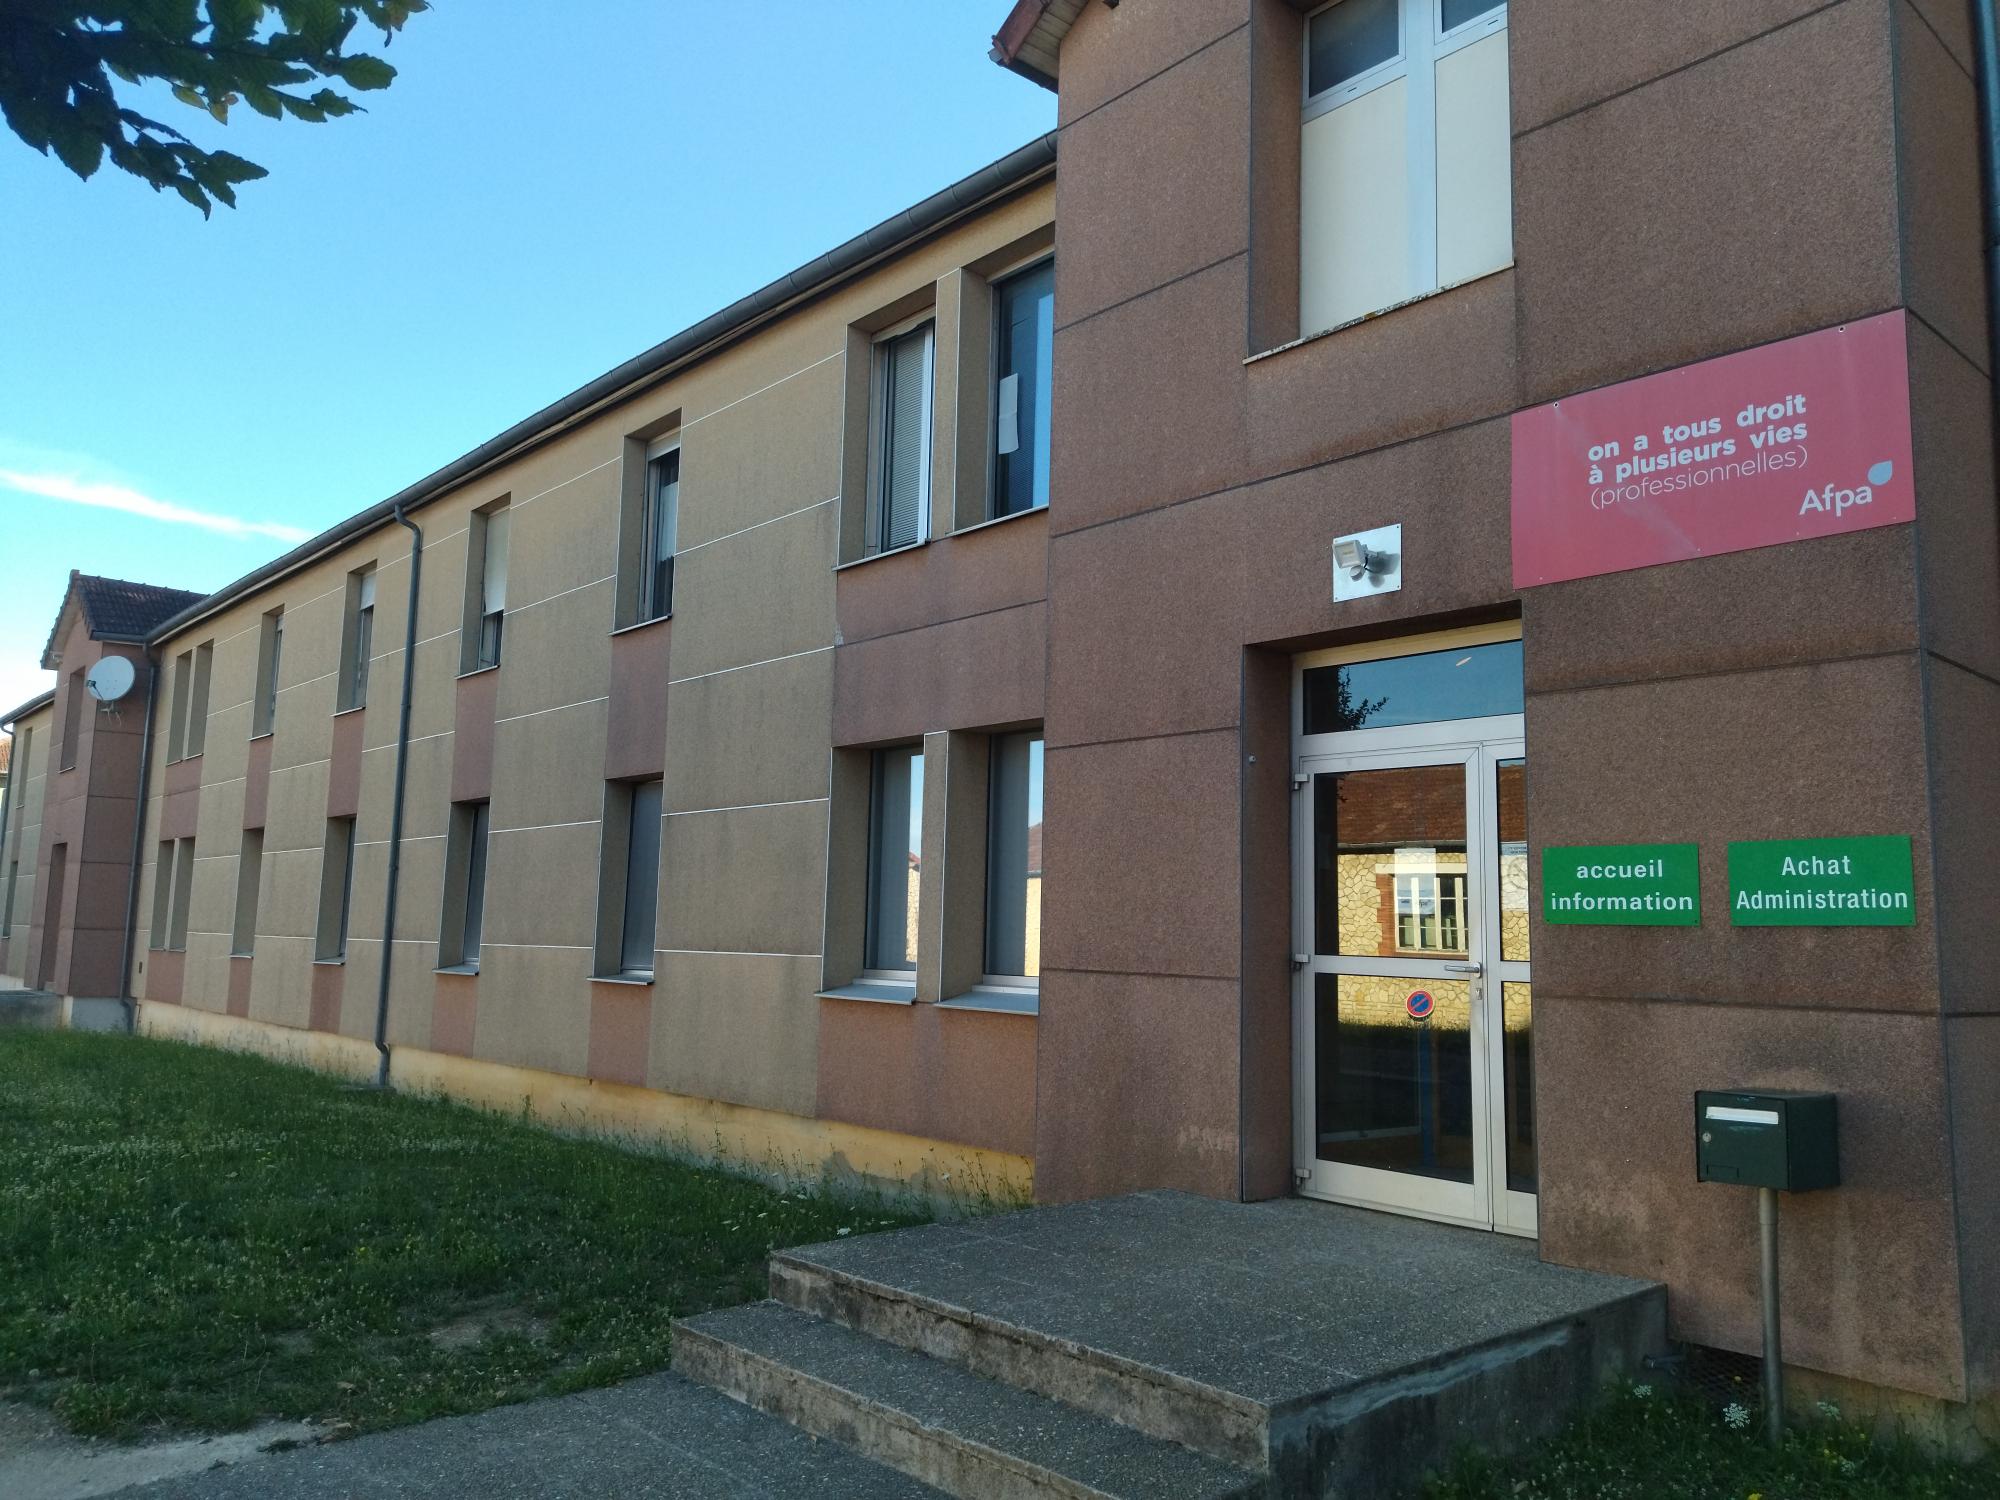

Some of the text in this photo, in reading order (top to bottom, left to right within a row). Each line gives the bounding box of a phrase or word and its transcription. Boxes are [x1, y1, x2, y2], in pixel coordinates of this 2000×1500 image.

[1588, 394, 1807, 461] on a tous droit
[1588, 423, 1808, 485] à plusieurs vies
[1591, 444, 1808, 510] (professionnelles)
[1799, 483, 1873, 516] Afpa
[1576, 859, 1663, 879] accueil
[1781, 855, 1851, 876] Achat
[1551, 892, 1693, 910] information
[1736, 888, 1908, 909] Administration
